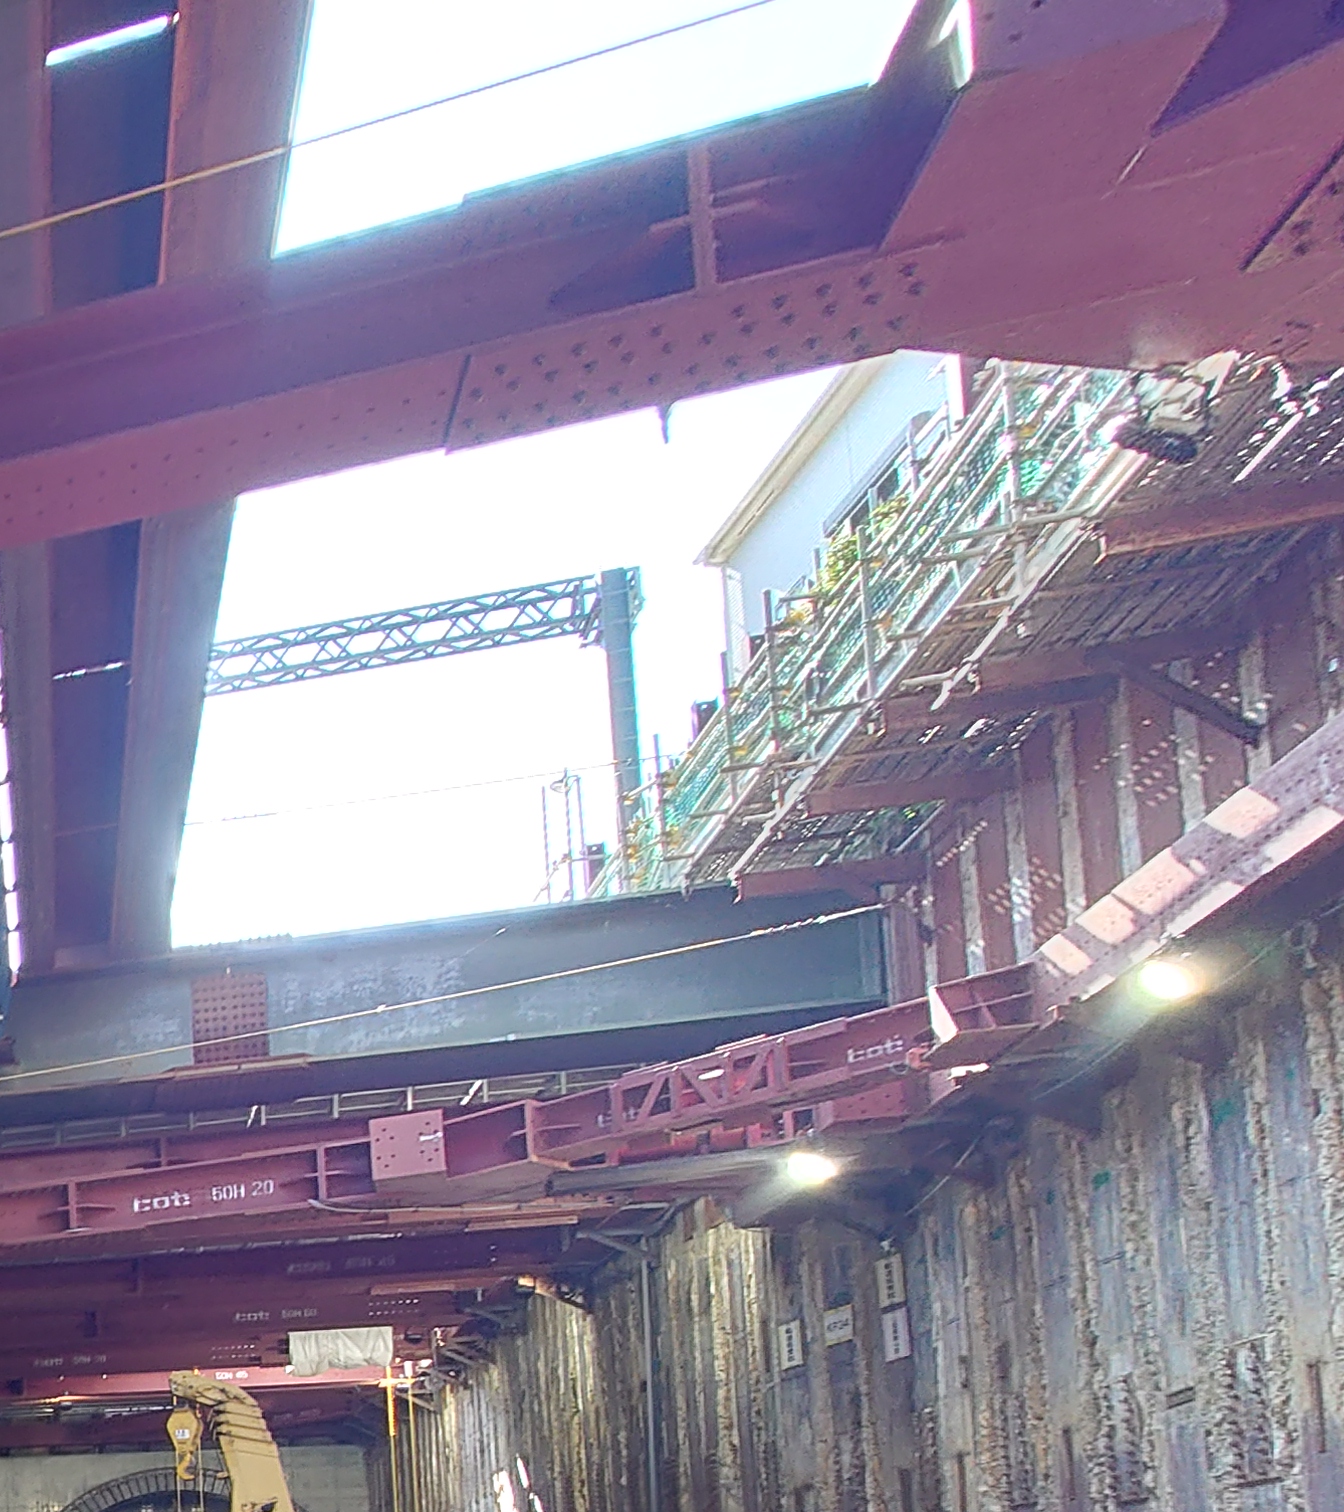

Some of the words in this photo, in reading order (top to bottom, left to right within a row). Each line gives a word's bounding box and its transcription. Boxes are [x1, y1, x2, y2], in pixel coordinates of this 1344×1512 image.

[132, 1190, 191, 1213] ヒロセ
[211, 1183, 246, 1202] 50H
[252, 1179, 274, 1197] 20
